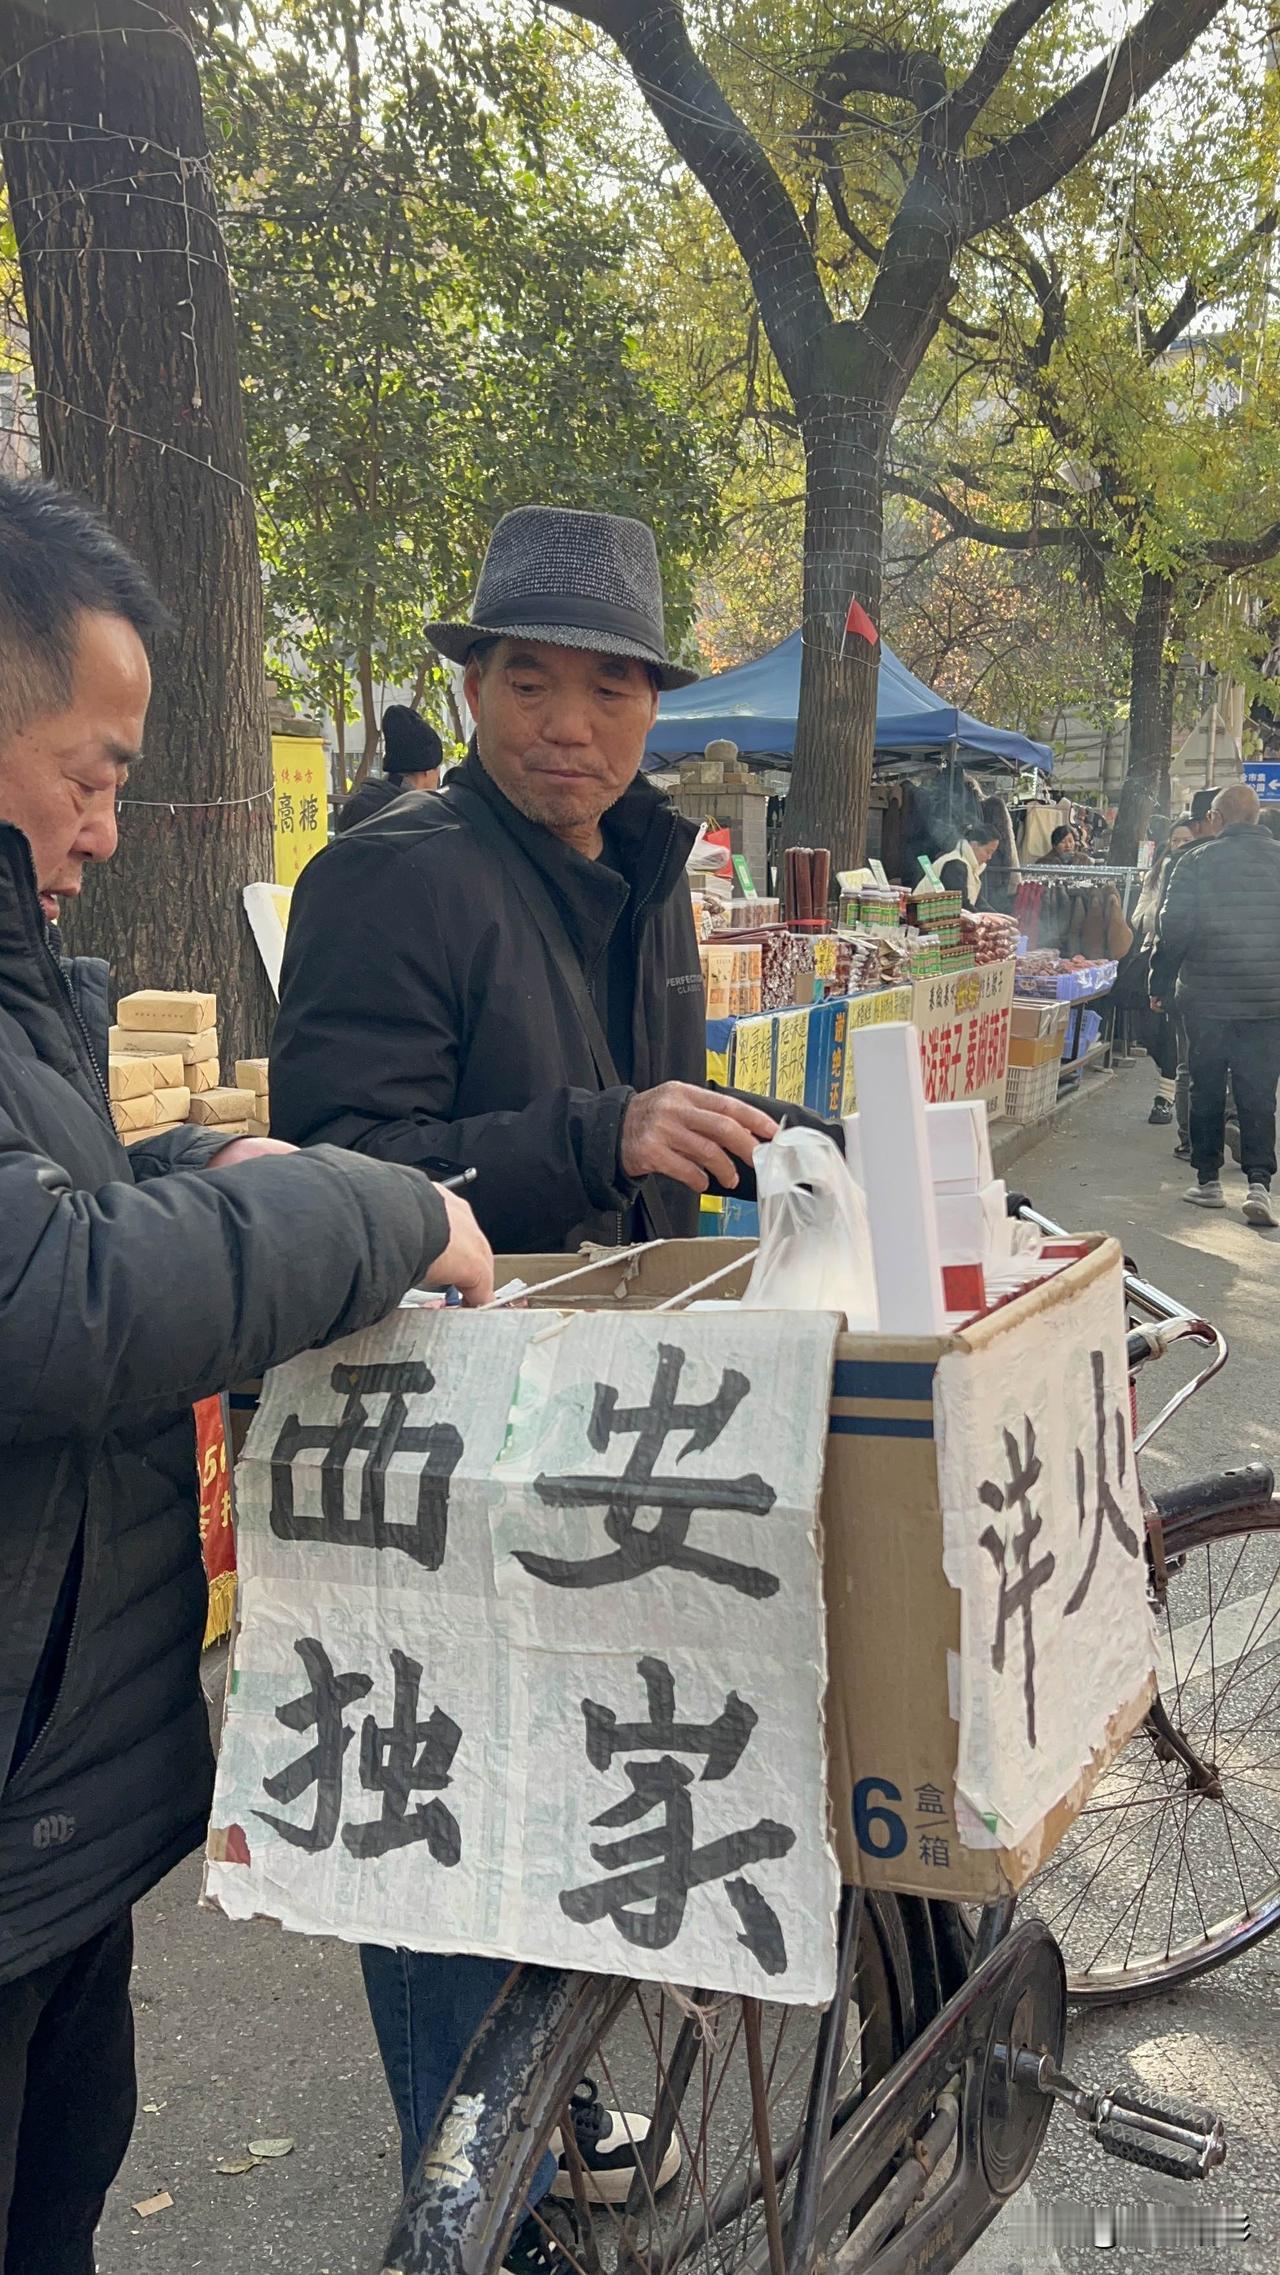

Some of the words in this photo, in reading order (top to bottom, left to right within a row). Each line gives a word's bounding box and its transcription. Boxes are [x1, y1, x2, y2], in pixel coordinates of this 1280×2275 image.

[272, 768, 313, 784] 传秘方
[272, 793, 319, 834] 膏糖
[828, 1012, 847, 1118] 谢绝还
[270, 1342, 780, 1600] 西安
[250, 1637, 797, 1976] 独家
[852, 1777, 908, 1860] 6
